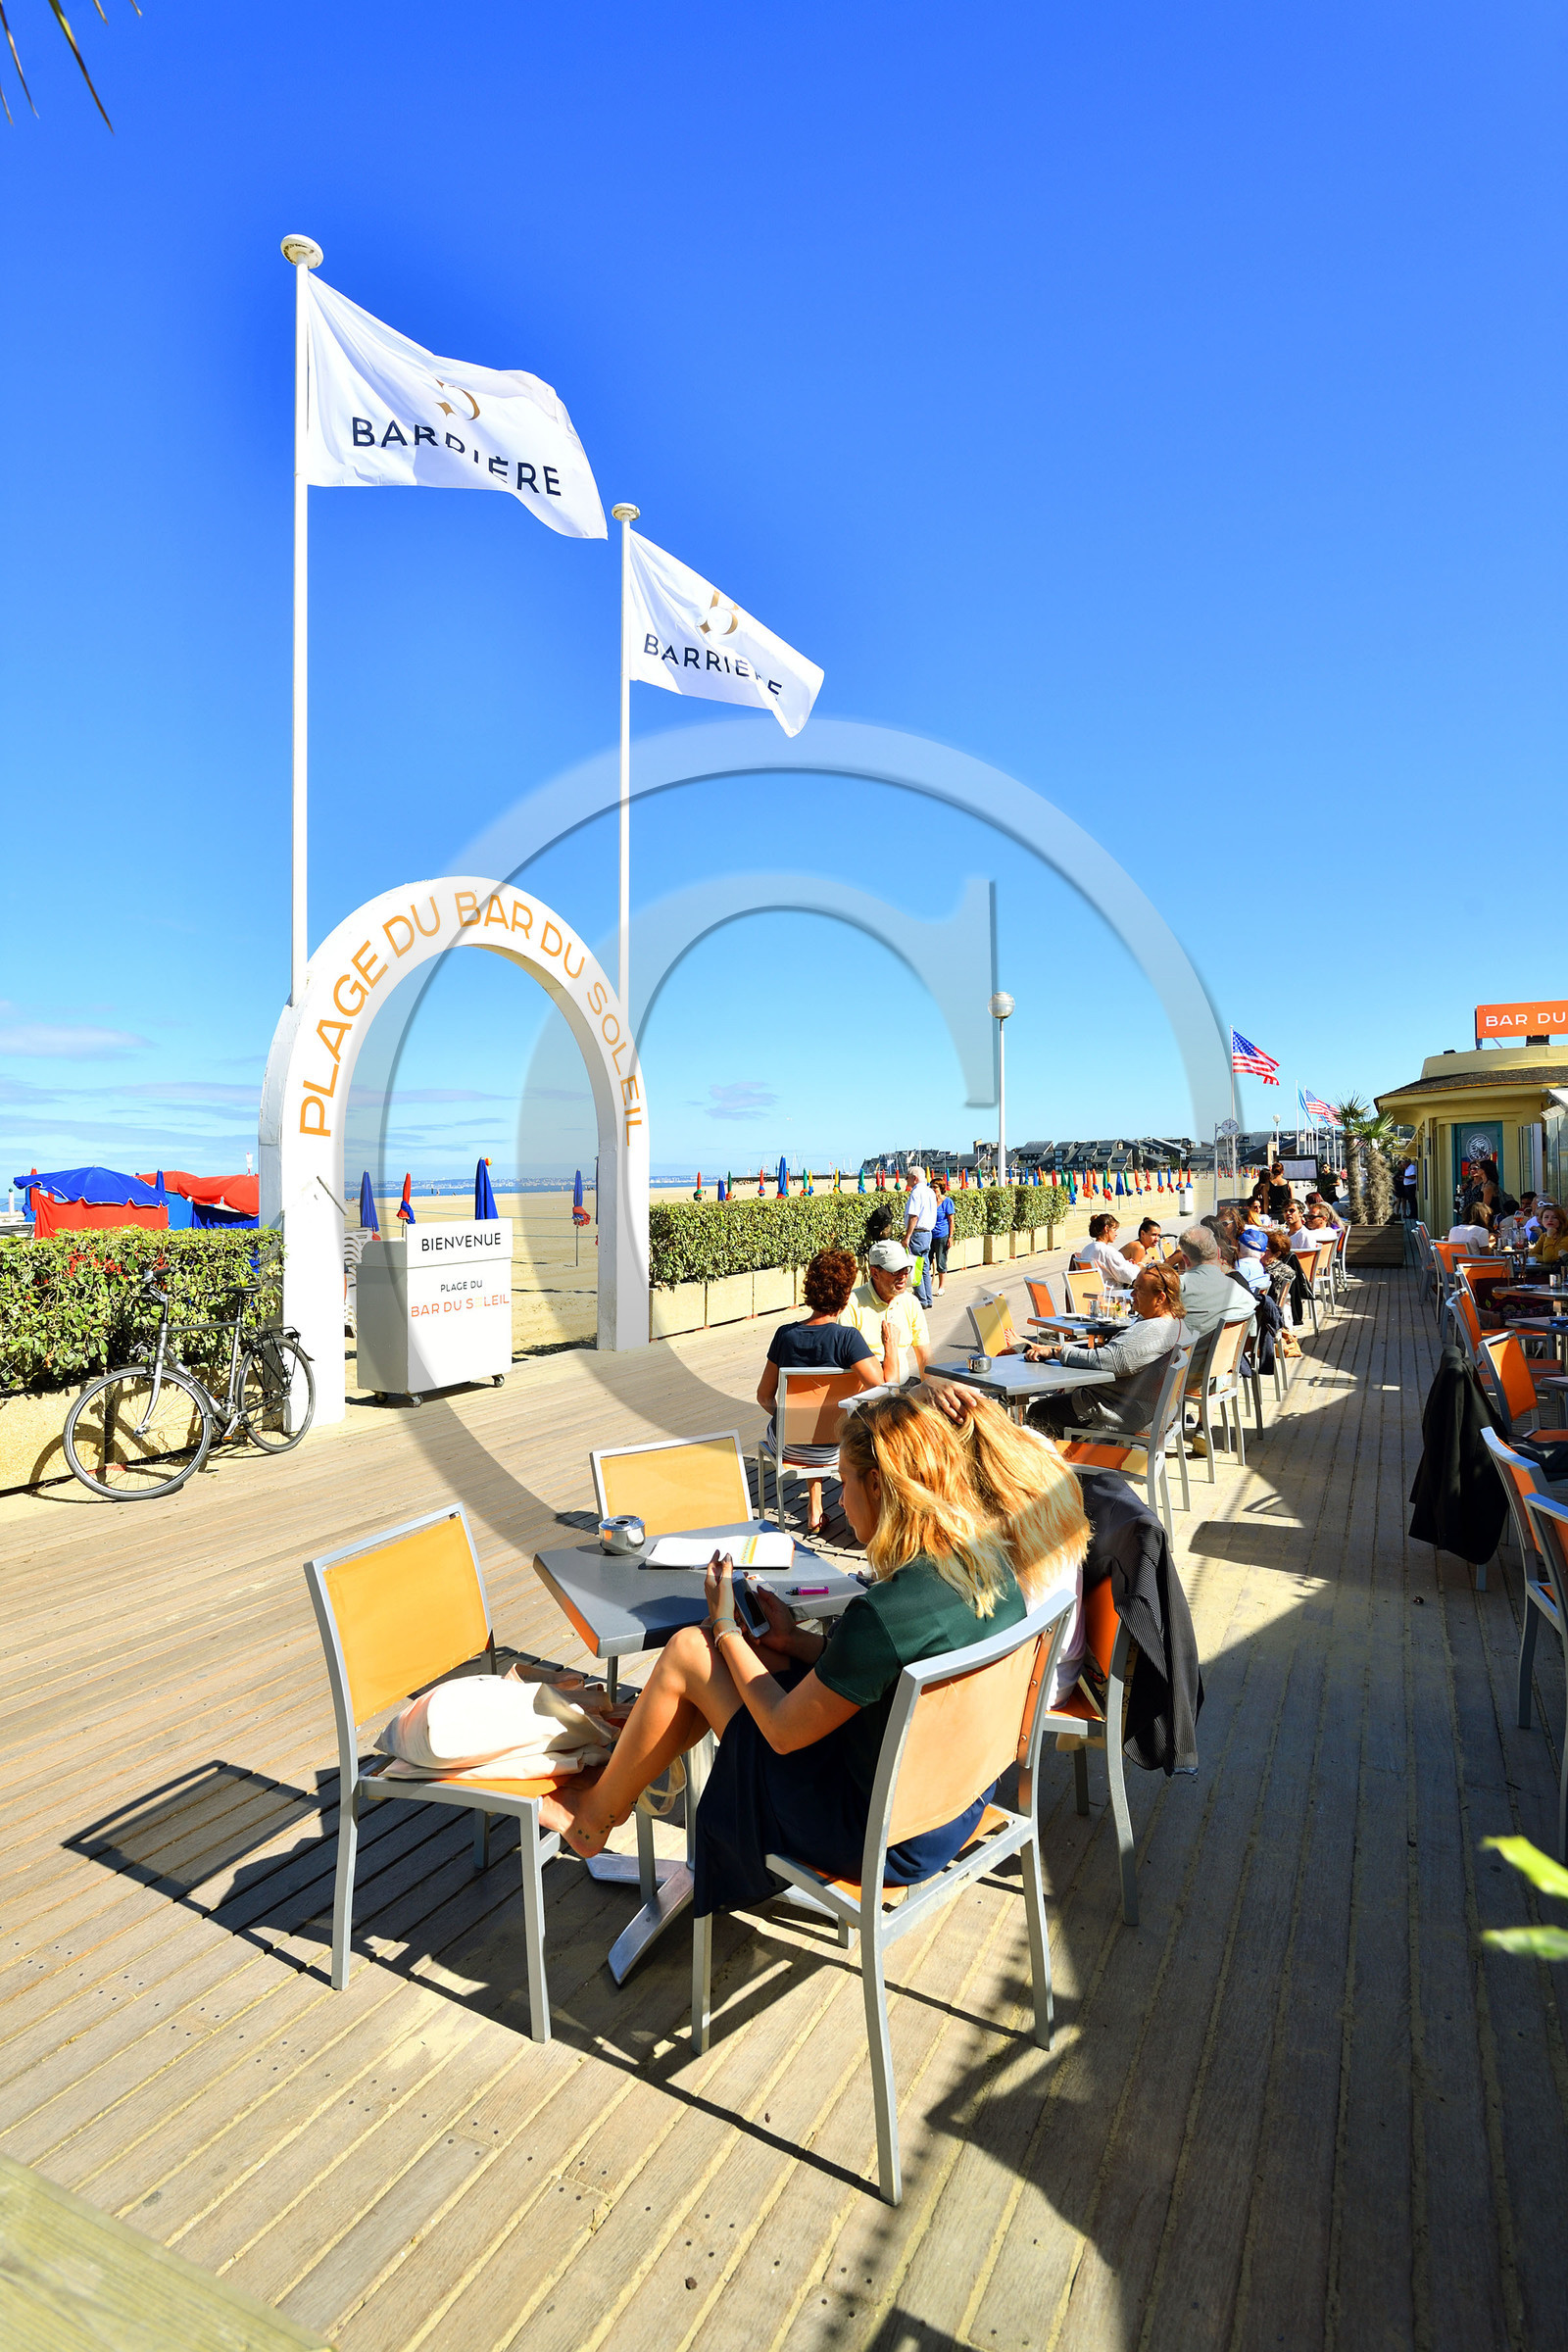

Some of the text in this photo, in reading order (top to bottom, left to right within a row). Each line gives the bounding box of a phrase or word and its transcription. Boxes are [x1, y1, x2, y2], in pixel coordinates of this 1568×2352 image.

[299, 890, 643, 1148] PLAGE DU BAR DU SOLEIL
[1485, 1011, 1566, 1027] BAR DU
[421, 1232, 502, 1251] BIENVENUE
[440, 1279, 483, 1293] PLAGE DU
[411, 1294, 510, 1317] BAR DU SLEIL
